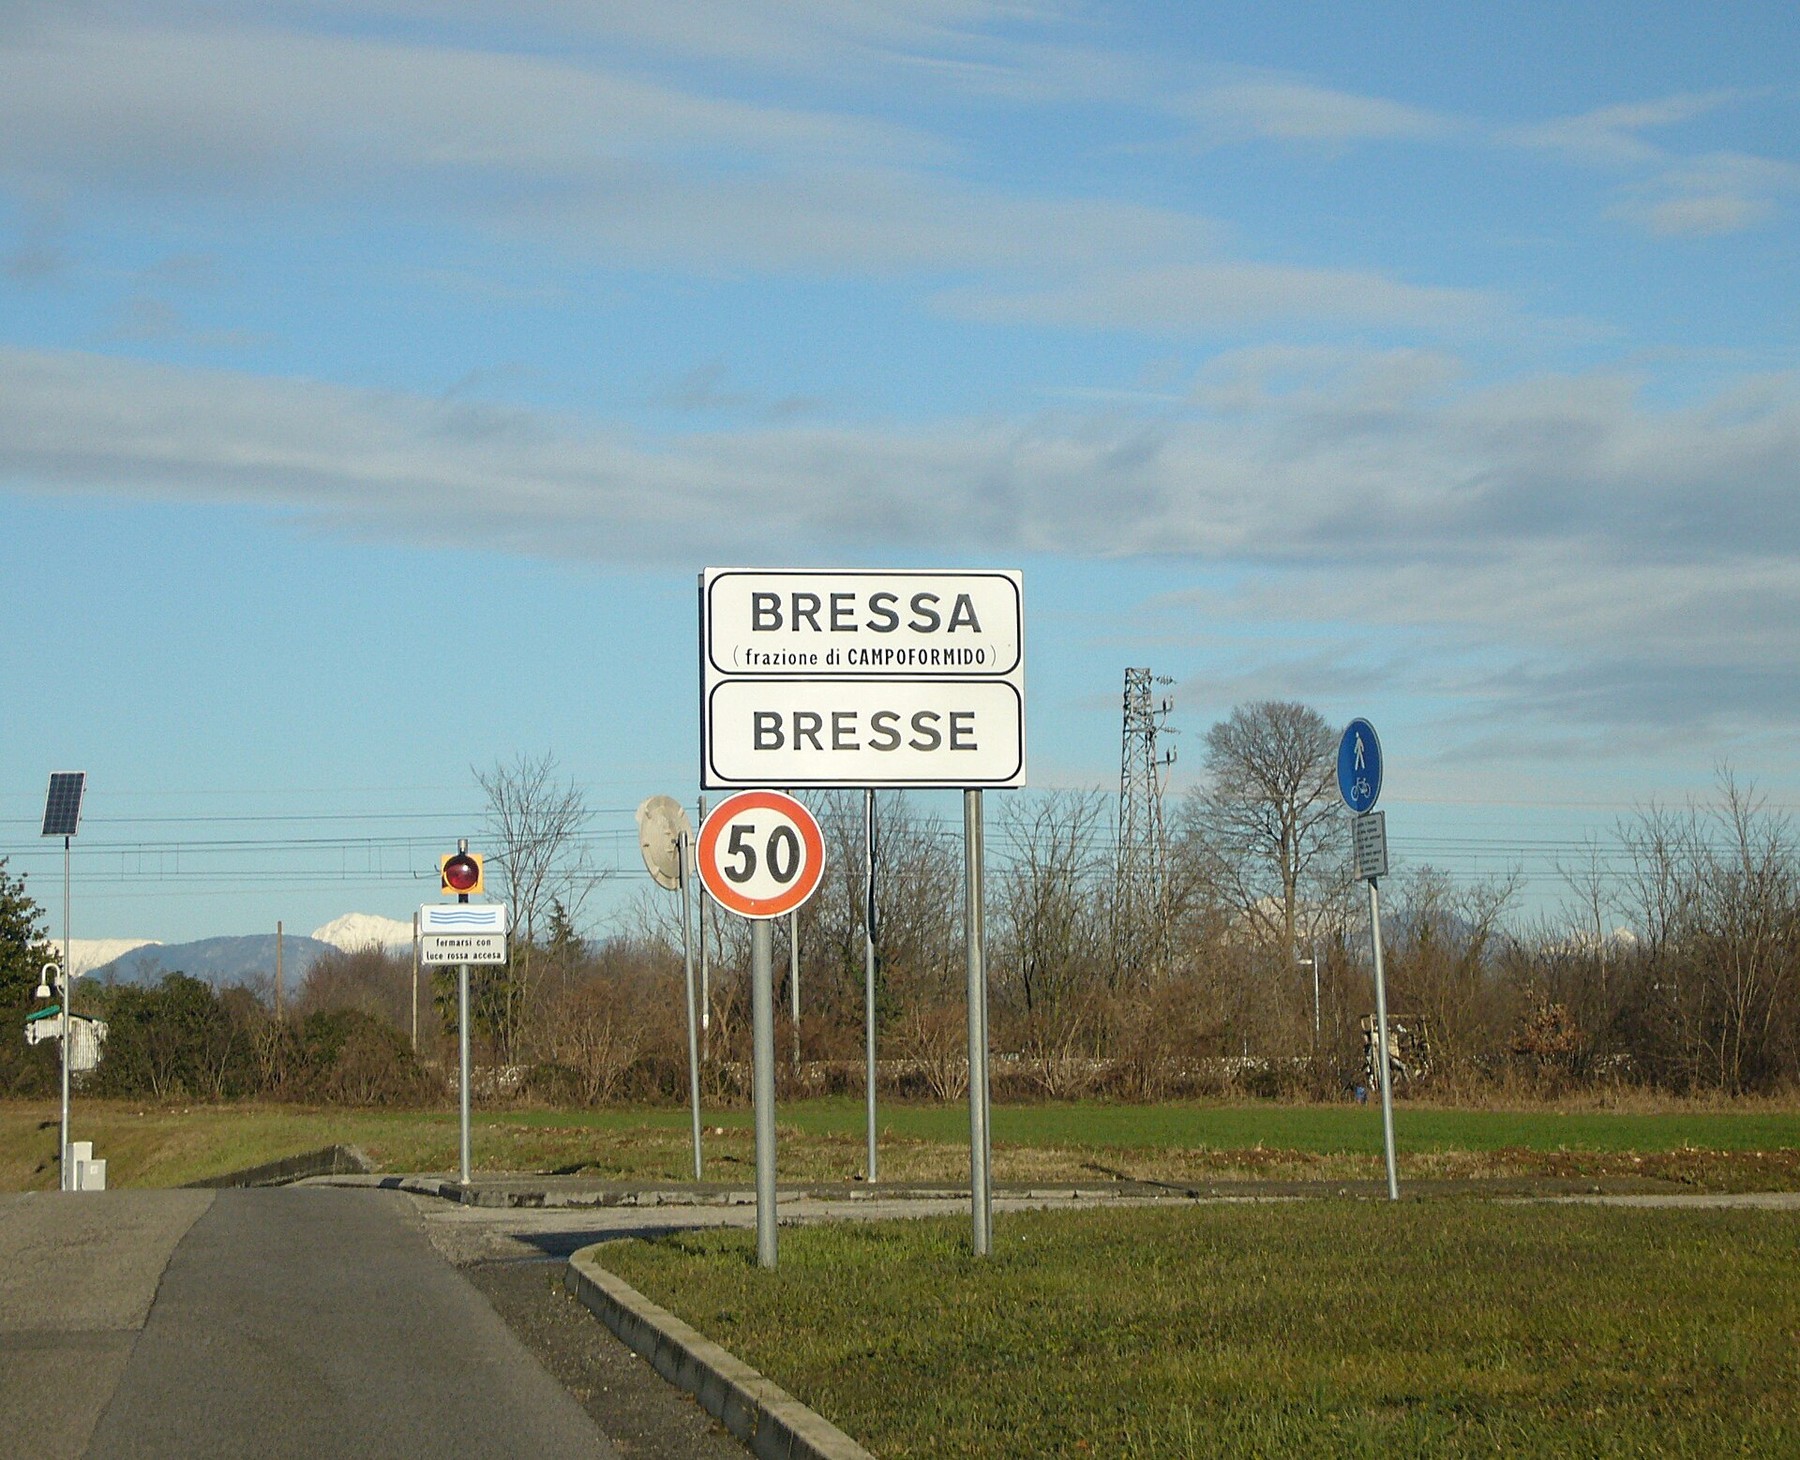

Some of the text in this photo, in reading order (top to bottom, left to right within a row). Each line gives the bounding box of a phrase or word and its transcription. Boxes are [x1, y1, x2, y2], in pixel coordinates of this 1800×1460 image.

[752, 592, 982, 634] BRESSA
[826, 648, 840, 665] di
[754, 711, 978, 752] BRESSE
[725, 823, 800, 883] 50
[426, 951, 501, 960] luce rossa accesa
[436, 938, 472, 947] fermarsi
